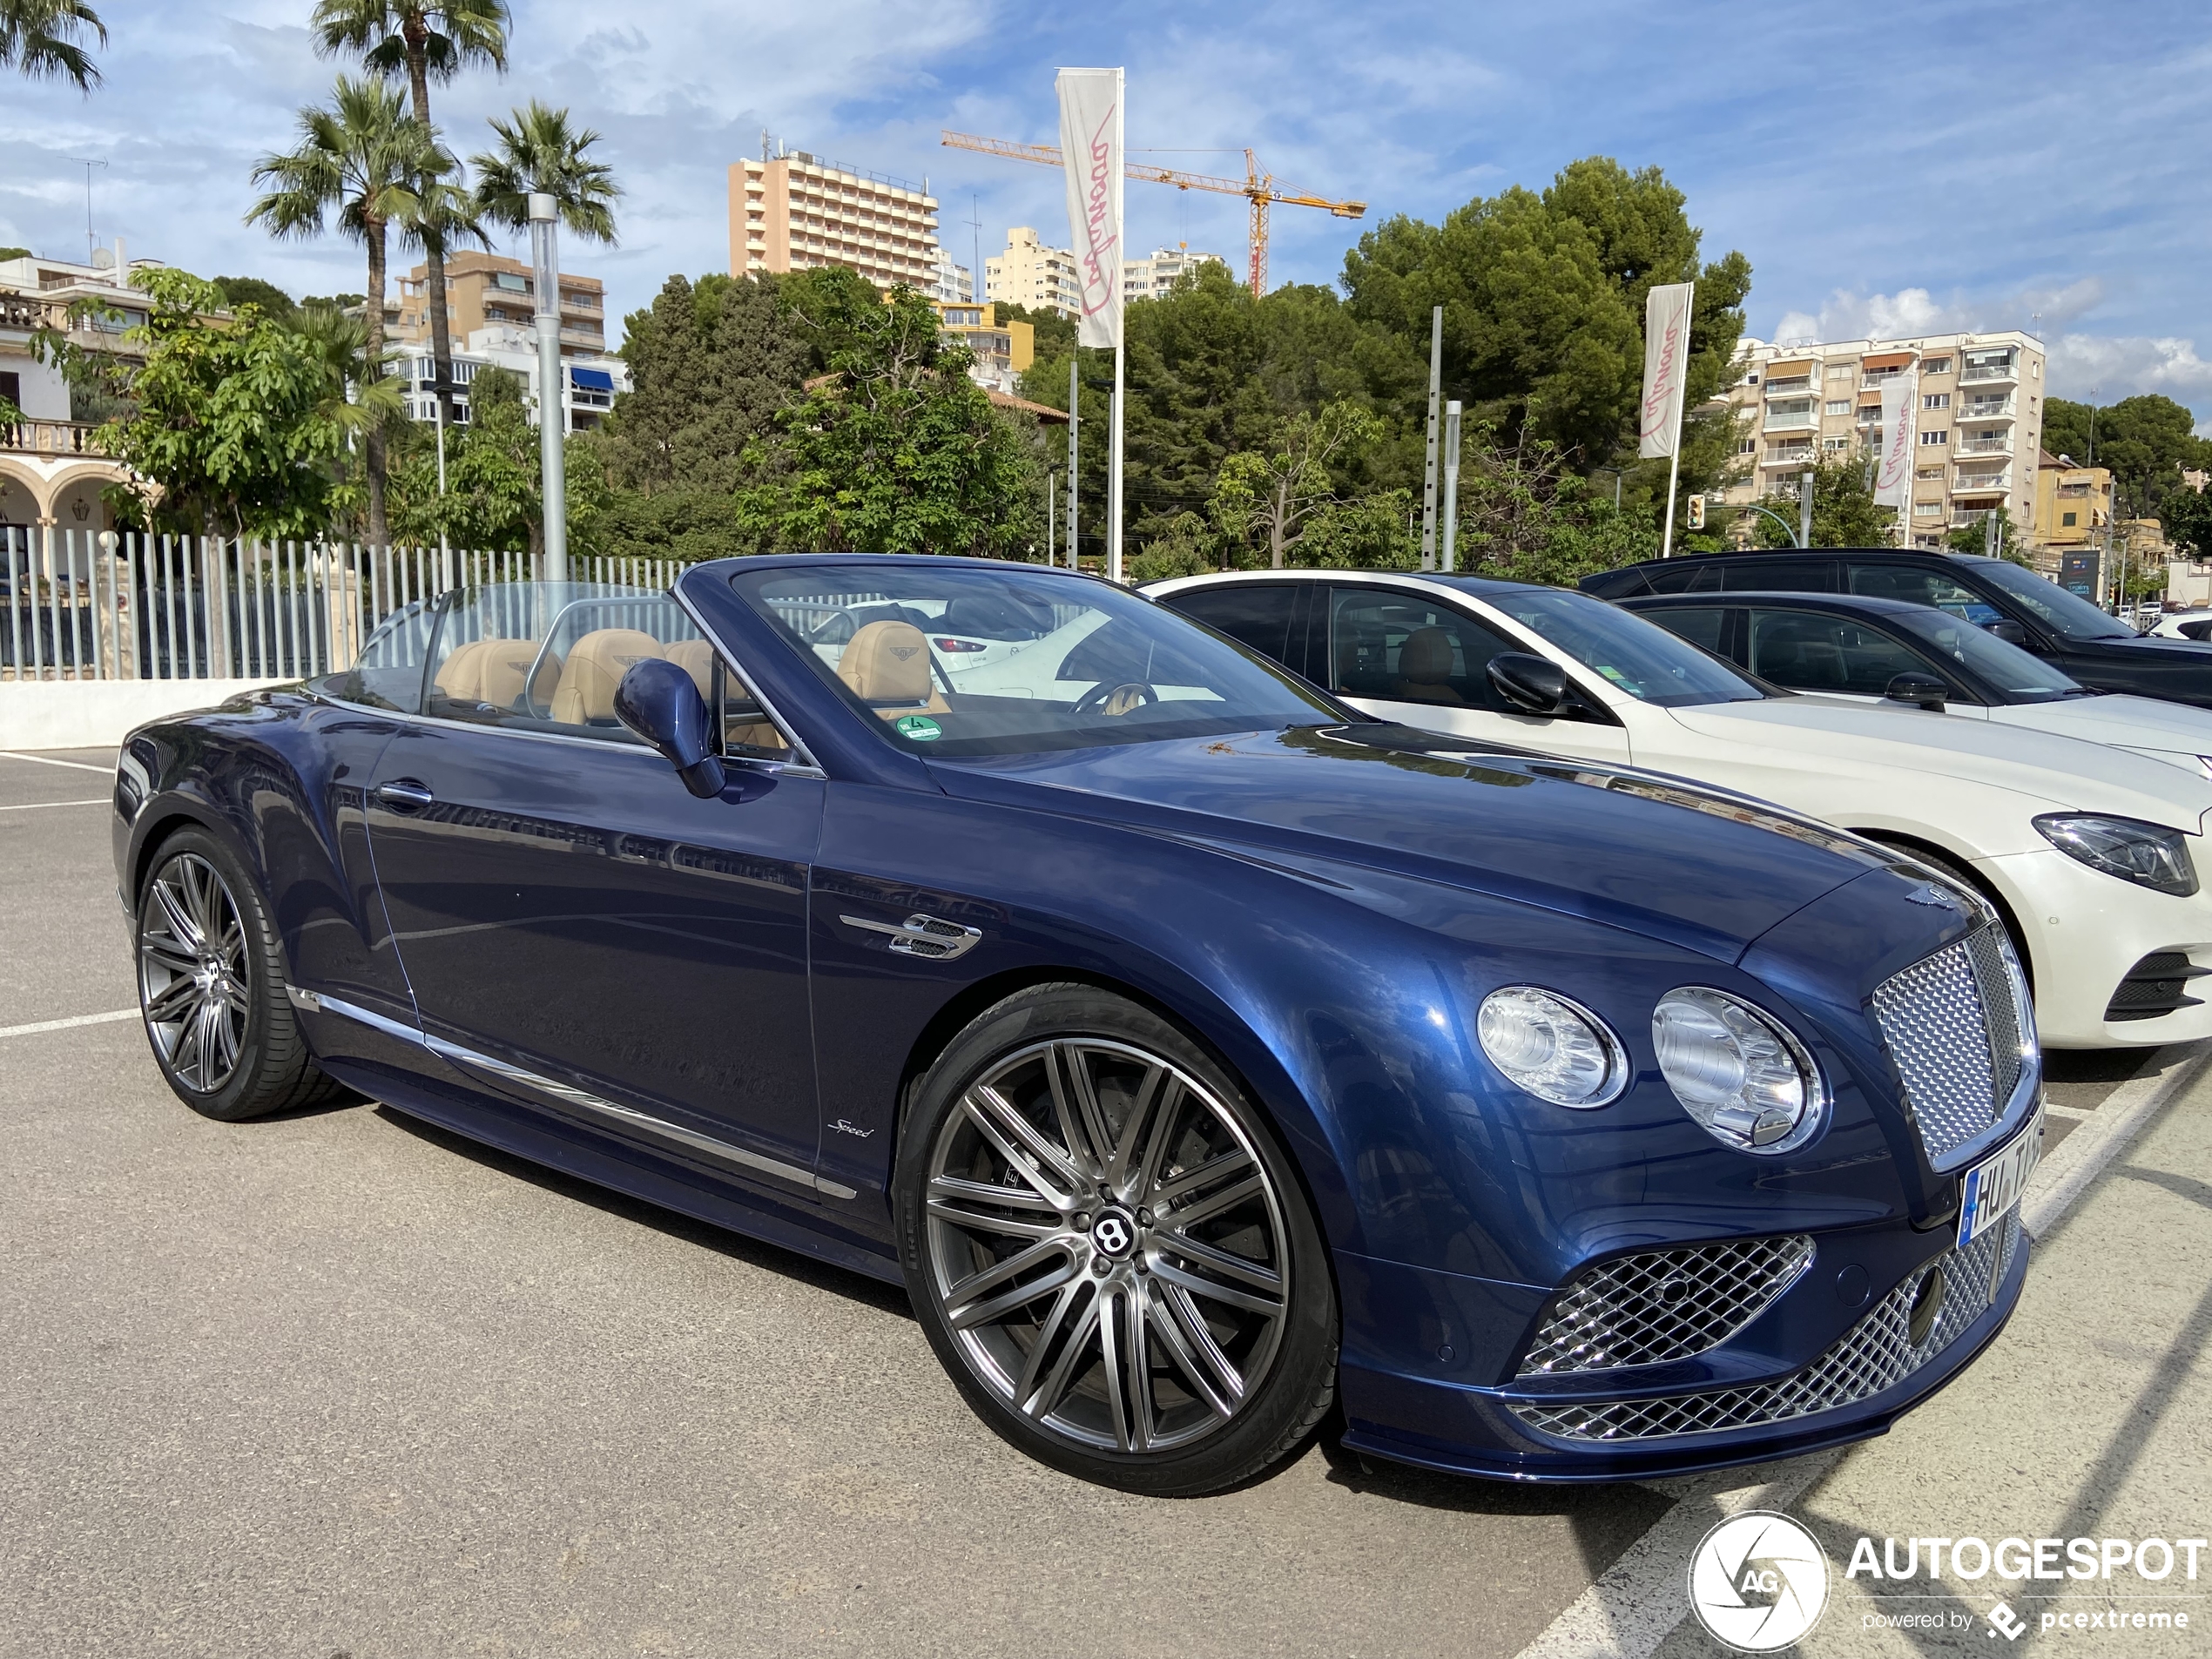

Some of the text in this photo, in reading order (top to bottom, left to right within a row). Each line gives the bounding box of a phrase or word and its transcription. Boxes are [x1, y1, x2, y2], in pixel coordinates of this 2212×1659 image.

[911, 718, 923, 728] 4
[827, 1119, 874, 1137] Speed
[1974, 1159, 2005, 1229] HU
[1963, 1217, 1969, 1232] D
[1096, 1218, 1129, 1252] B
